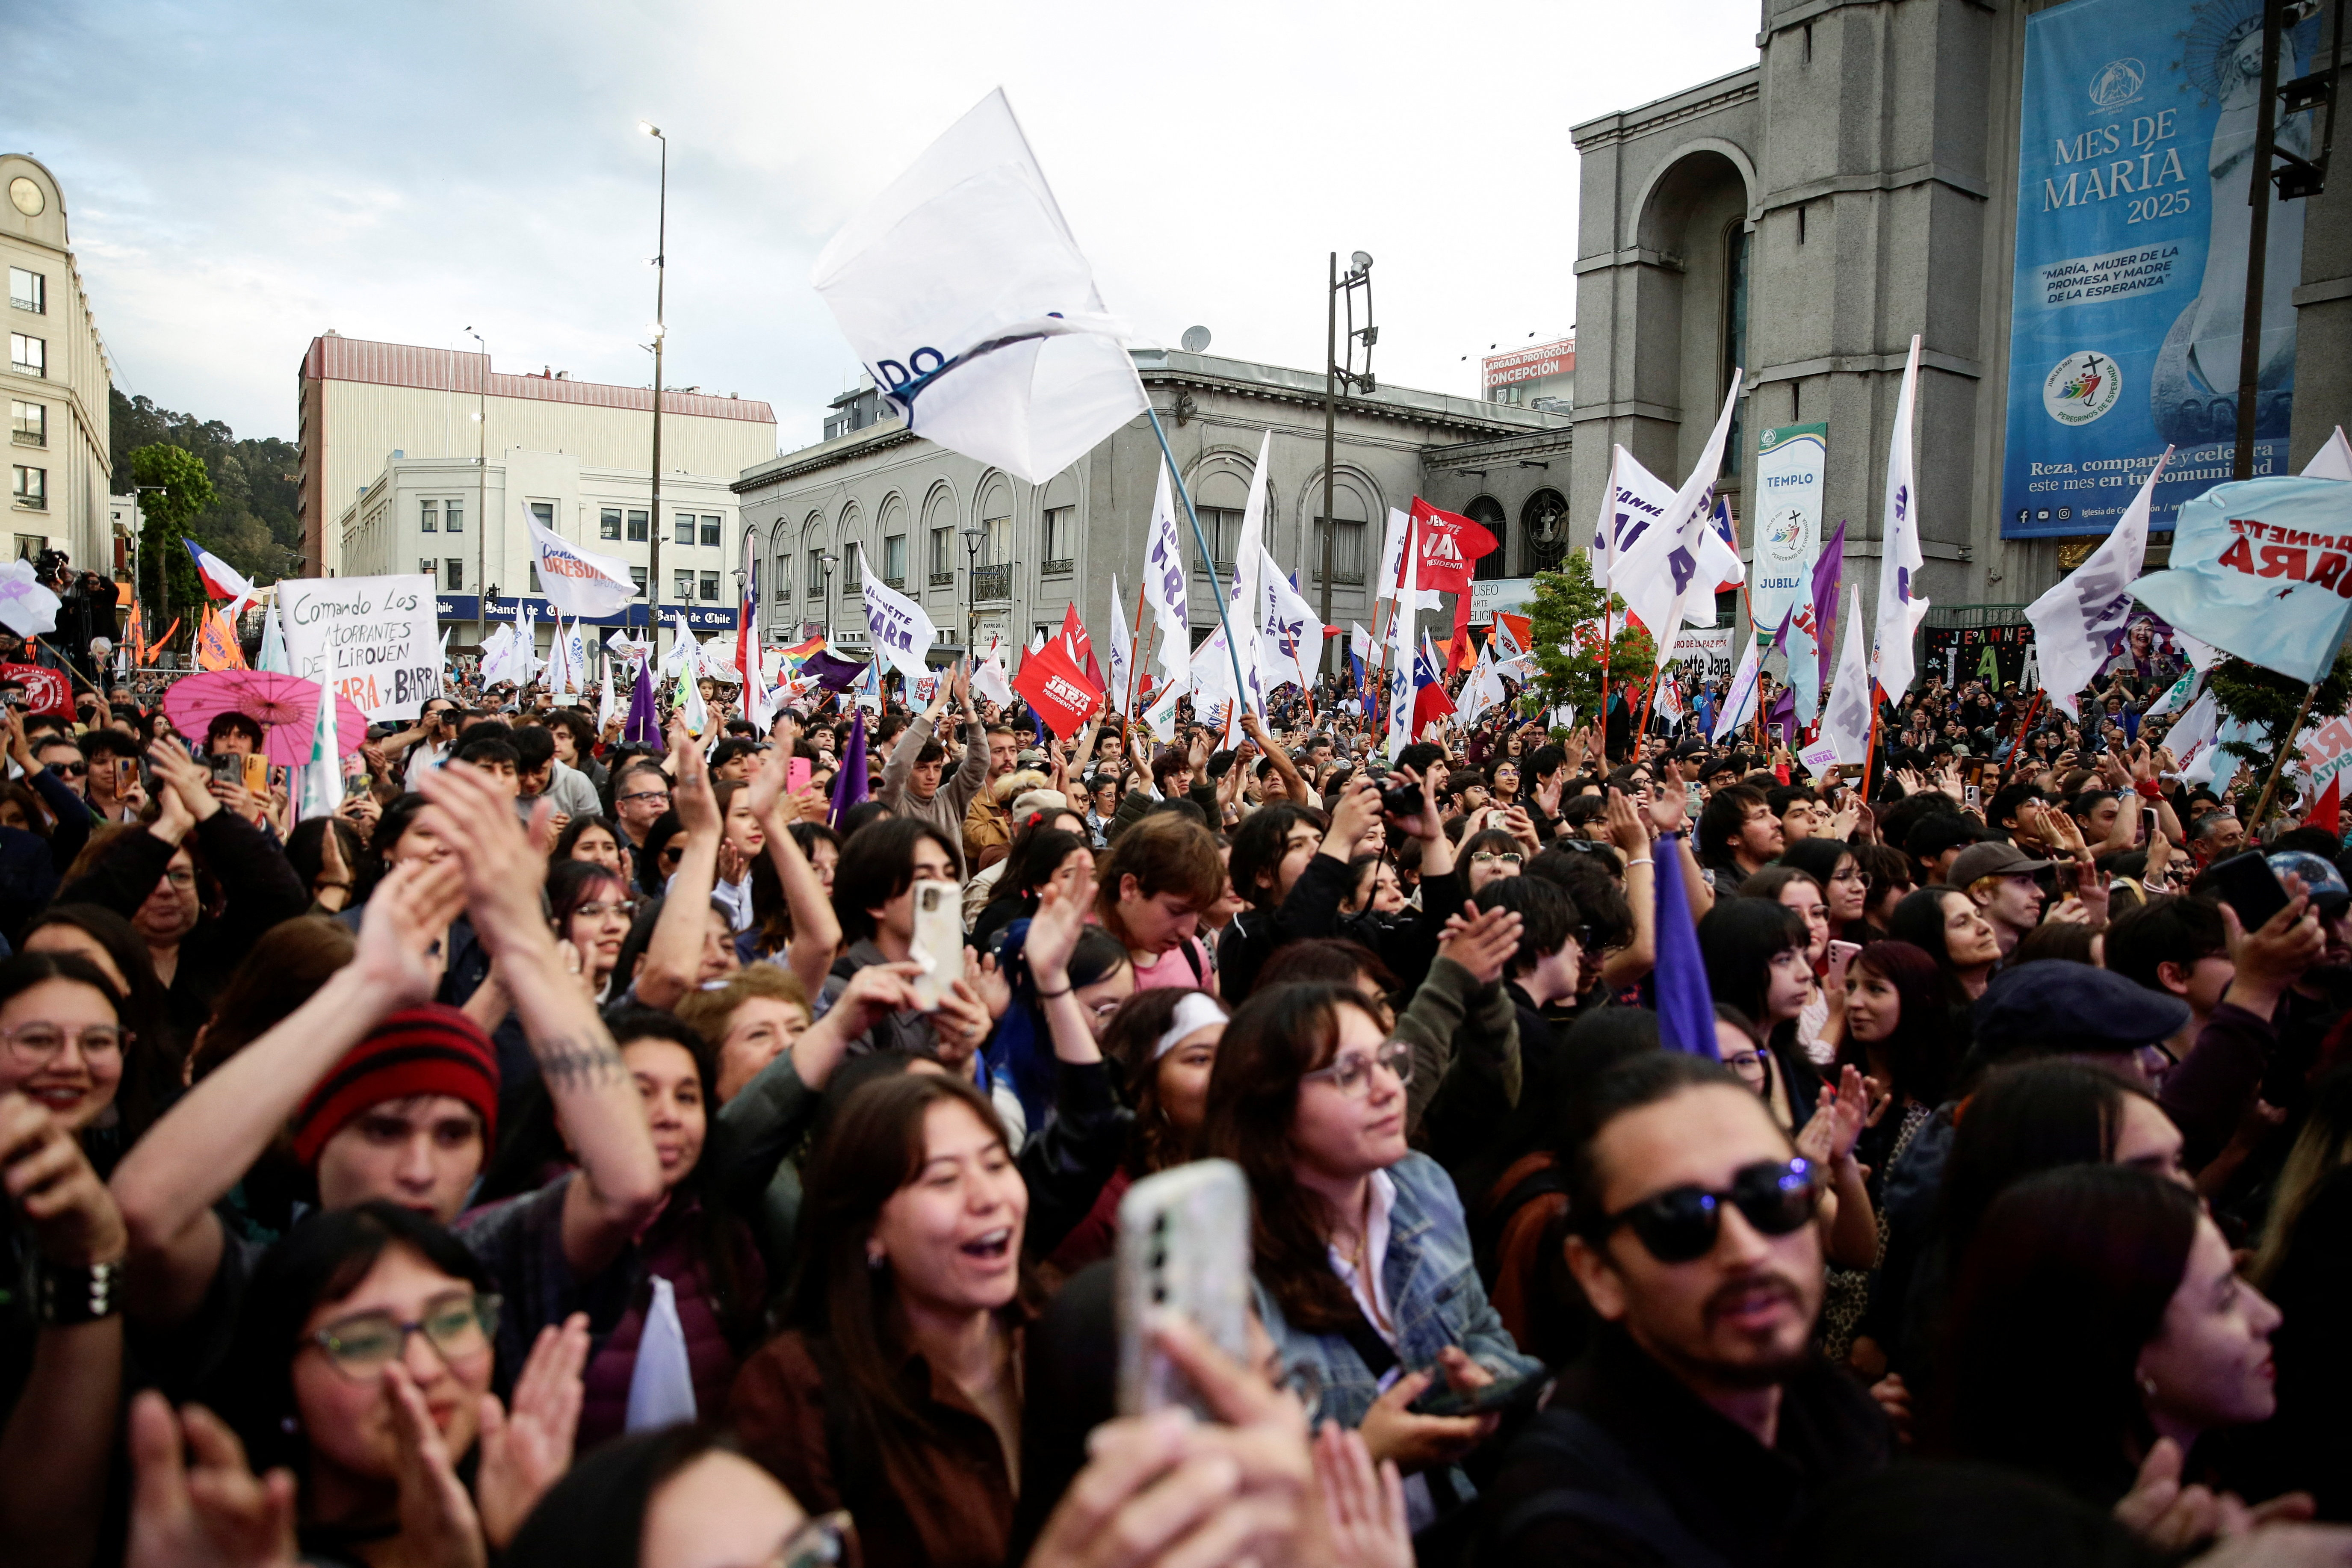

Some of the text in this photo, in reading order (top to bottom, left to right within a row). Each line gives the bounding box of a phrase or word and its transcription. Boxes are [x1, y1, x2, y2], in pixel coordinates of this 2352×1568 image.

[2054, 108, 2177, 165] MES DE
[2042, 141, 2187, 212] MARÍA
[2127, 189, 2190, 224] 2025
[2093, 255, 2137, 272] MUJER
[2139, 250, 2159, 262] DE
[2161, 246, 2178, 258] LA
[2047, 260, 2172, 291] PROMESA Y MADRE
[2048, 292, 2065, 303] DE
[2066, 289, 2081, 300] LA
[1484, 357, 1521, 372] LARGADA
[1484, 359, 1559, 387] CONCEPCIÓN
[2048, 358, 2072, 387] JUBILEO 2025
[2057, 364, 2117, 422] PEREGRINOS DE ESPERANZA
[2030, 462, 2078, 476] Reza,
[2180, 452, 2191, 467] y
[2194, 444, 2273, 462] celera
[1767, 473, 1813, 487] TEMPLO
[2029, 459, 2273, 492] este mes en tu comuniad
[2082, 507, 2104, 517] Iglesia
[2107, 507, 2116, 515] de
[1766, 517, 1775, 533] JUBILEO
[1427, 559, 1463, 570] PRESIDENTA
[1771, 552, 1798, 561] PEREGRINOS
[593, 579, 623, 592] DIPUTAD
[1760, 577, 1800, 589] JUBILA
[294, 588, 418, 625] Comando Los
[485, 601, 517, 614] Banc
[527, 604, 539, 616] de
[657, 609, 731, 625] Bano de Chile
[1951, 626, 2036, 645] JEANNE
[303, 655, 325, 679] DE
[1708, 653, 1731, 676] Jara
[1943, 644, 2040, 692] JAR
[395, 667, 441, 705] BARRA
[1045, 679, 1088, 712] JARA
[1052, 674, 1092, 702] JEANNETTE
[1043, 688, 1075, 712] PRESIDENTA
